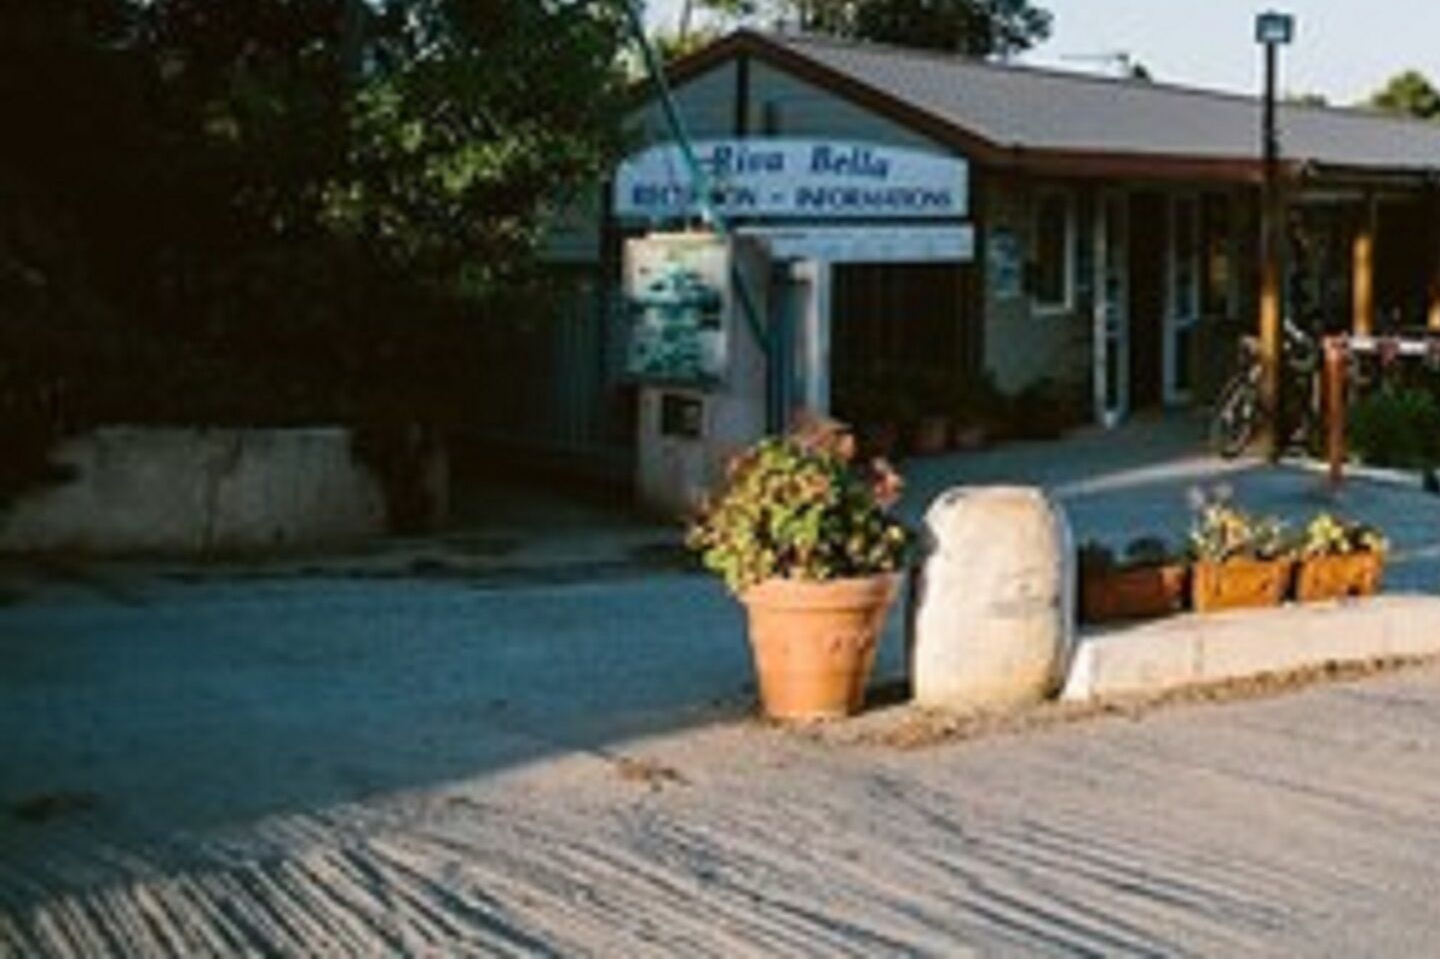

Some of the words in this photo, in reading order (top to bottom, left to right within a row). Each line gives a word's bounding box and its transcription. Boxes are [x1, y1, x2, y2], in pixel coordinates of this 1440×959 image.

[713, 145, 783, 175] Riva
[811, 145, 890, 181] Bella
[795, 186, 952, 207] INFORMATIONS
